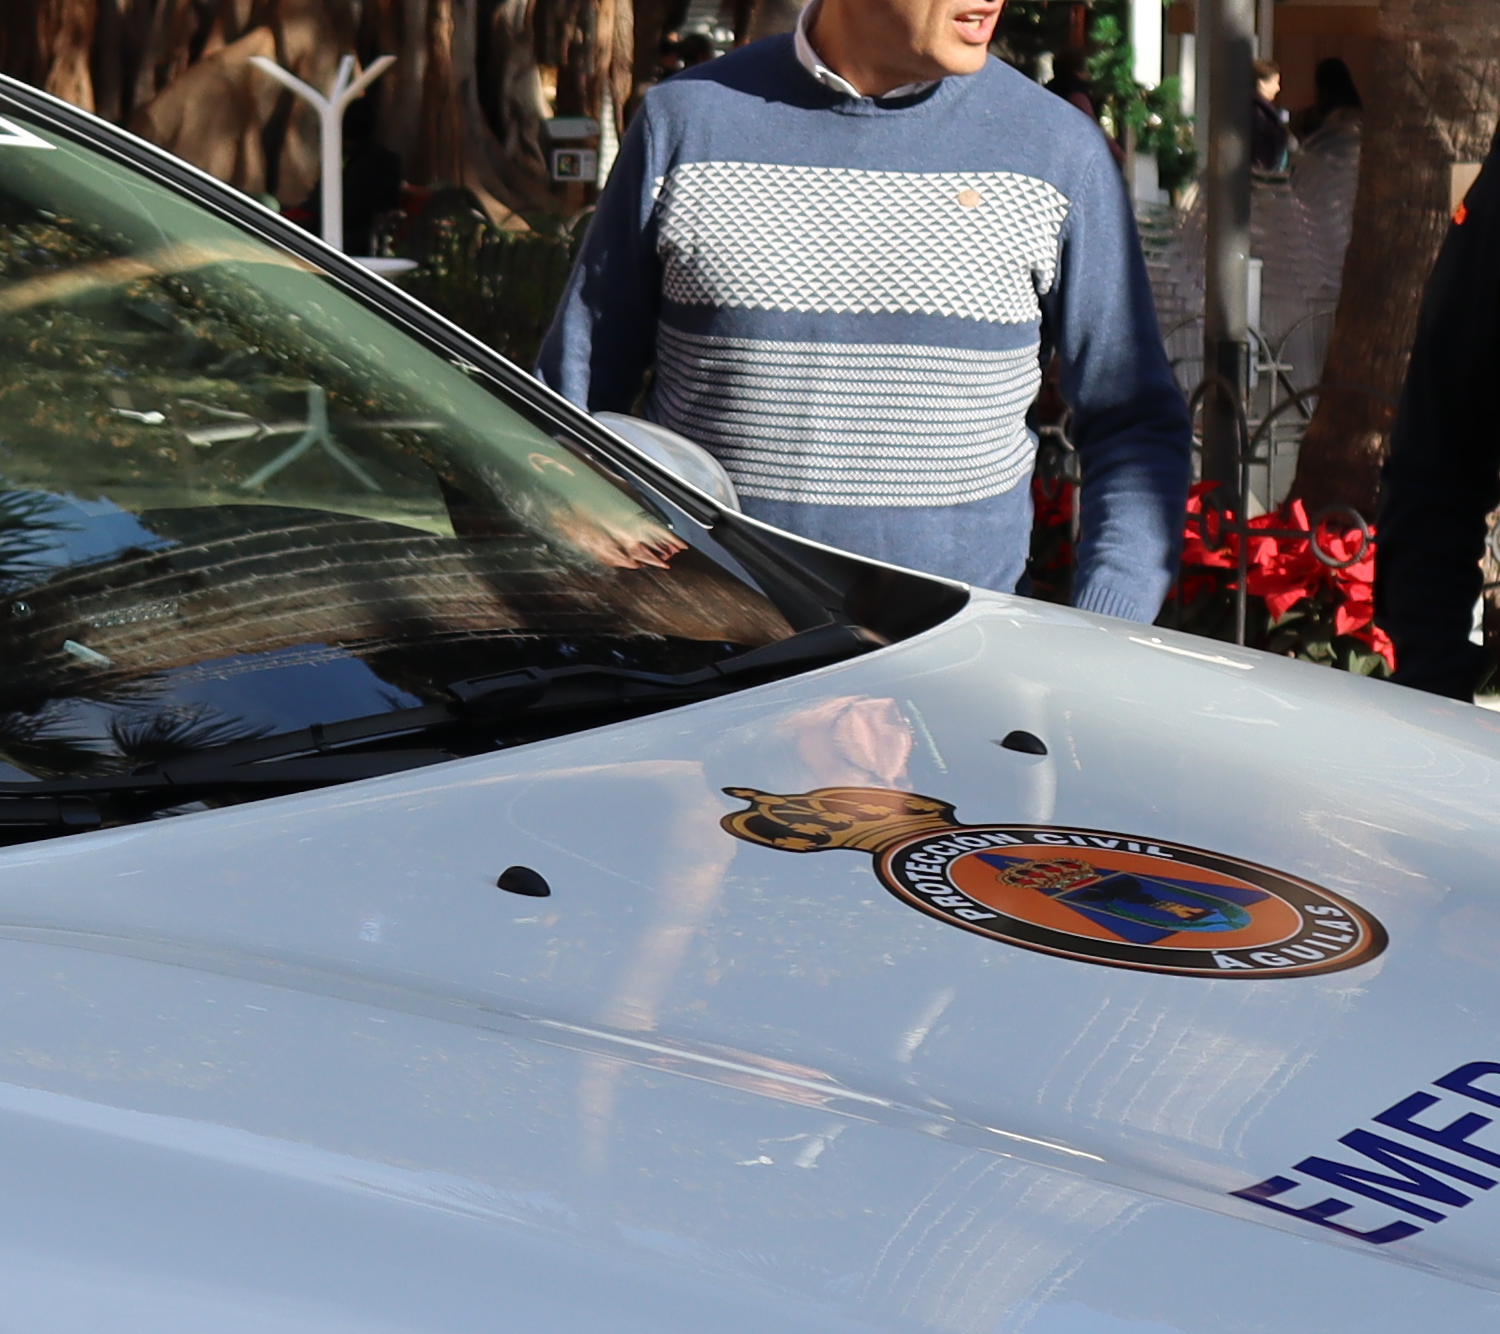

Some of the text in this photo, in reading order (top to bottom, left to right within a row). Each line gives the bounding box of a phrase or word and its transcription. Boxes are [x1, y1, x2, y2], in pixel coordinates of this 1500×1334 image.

[904, 831, 1174, 922] PROTECCIÓN CIVIL
[1212, 903, 1347, 971] ÁGUILAS
